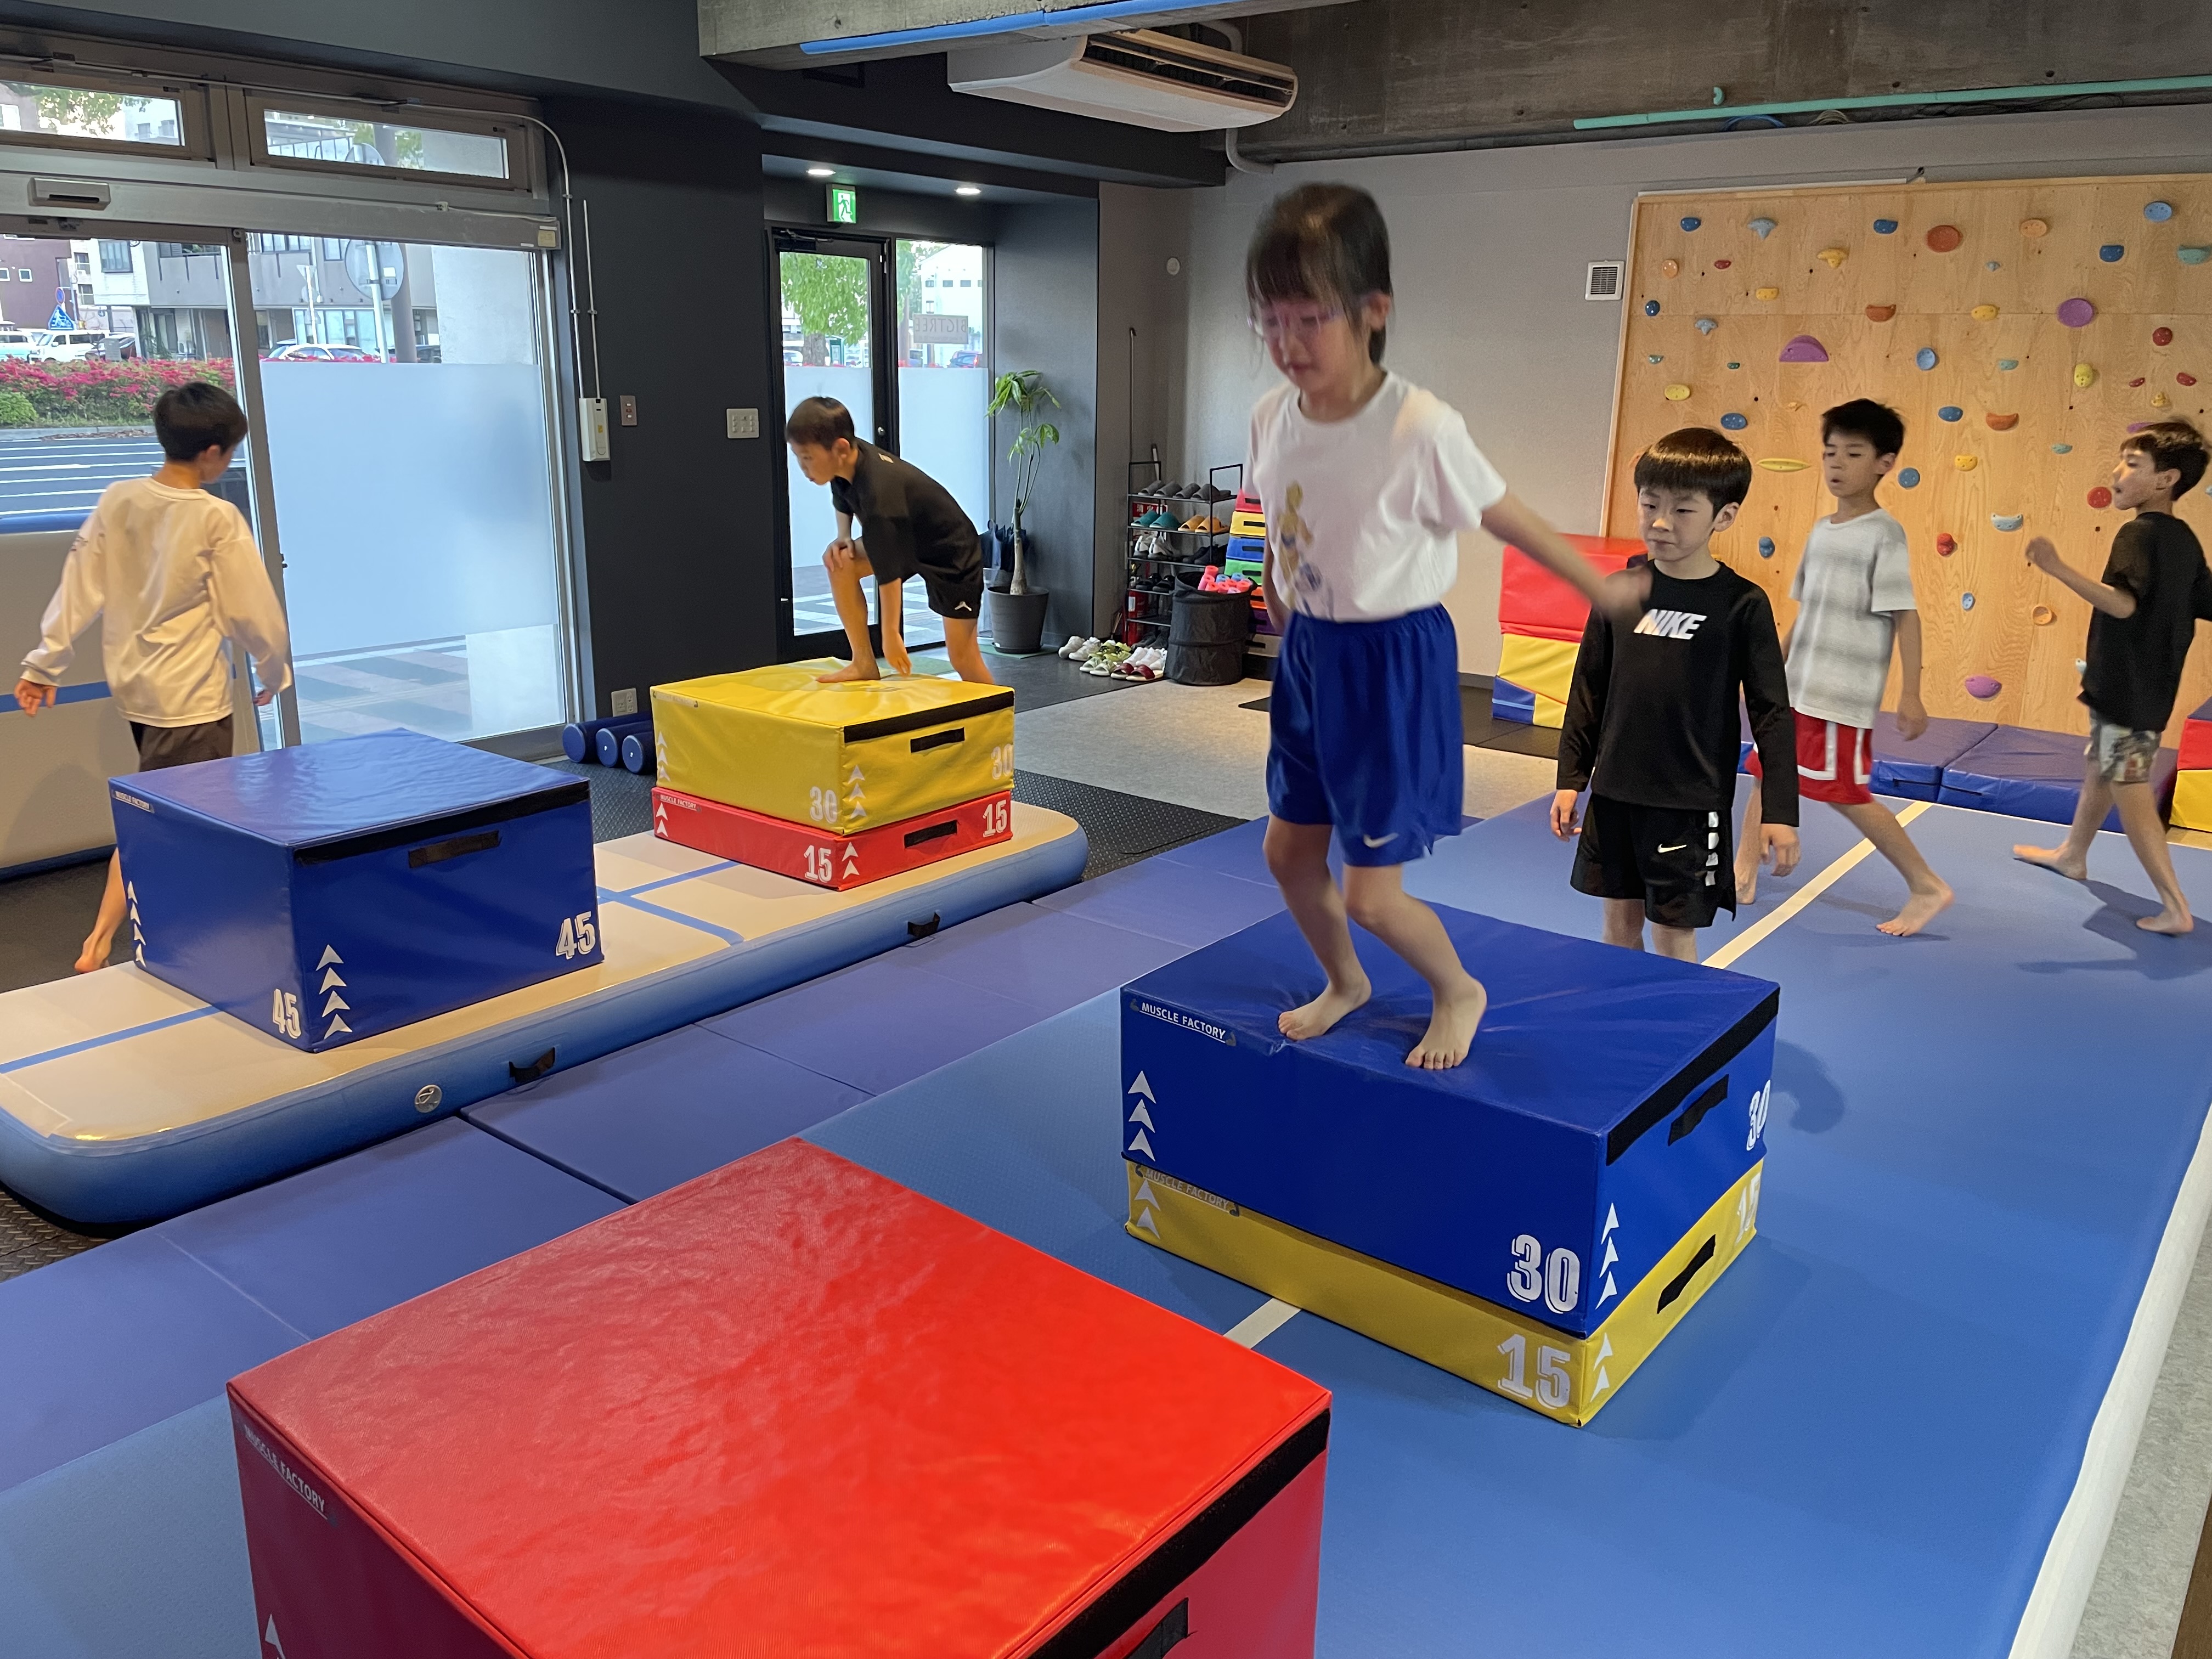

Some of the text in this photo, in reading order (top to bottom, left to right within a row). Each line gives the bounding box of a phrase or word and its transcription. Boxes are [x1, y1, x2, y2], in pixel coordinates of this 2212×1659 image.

[1633, 608, 1707, 640] NIKE
[991, 743, 1014, 780] 30
[677, 799, 697, 809] FACTORY
[810, 786, 837, 823] 30
[983, 799, 1007, 838] 15
[804, 845, 832, 883] 15
[556, 911, 596, 960] 45
[273, 988, 302, 1039] 45
[1142, 1002, 1226, 1040] MUSCLE FACTORY
[1746, 1079, 1771, 1151] 30
[1146, 1168, 1229, 1210] MUSCLE FACTORY
[1506, 1234, 1580, 1314] 30
[1497, 1334, 1571, 1409] 15
[280, 1460, 325, 1513] FACTORY
